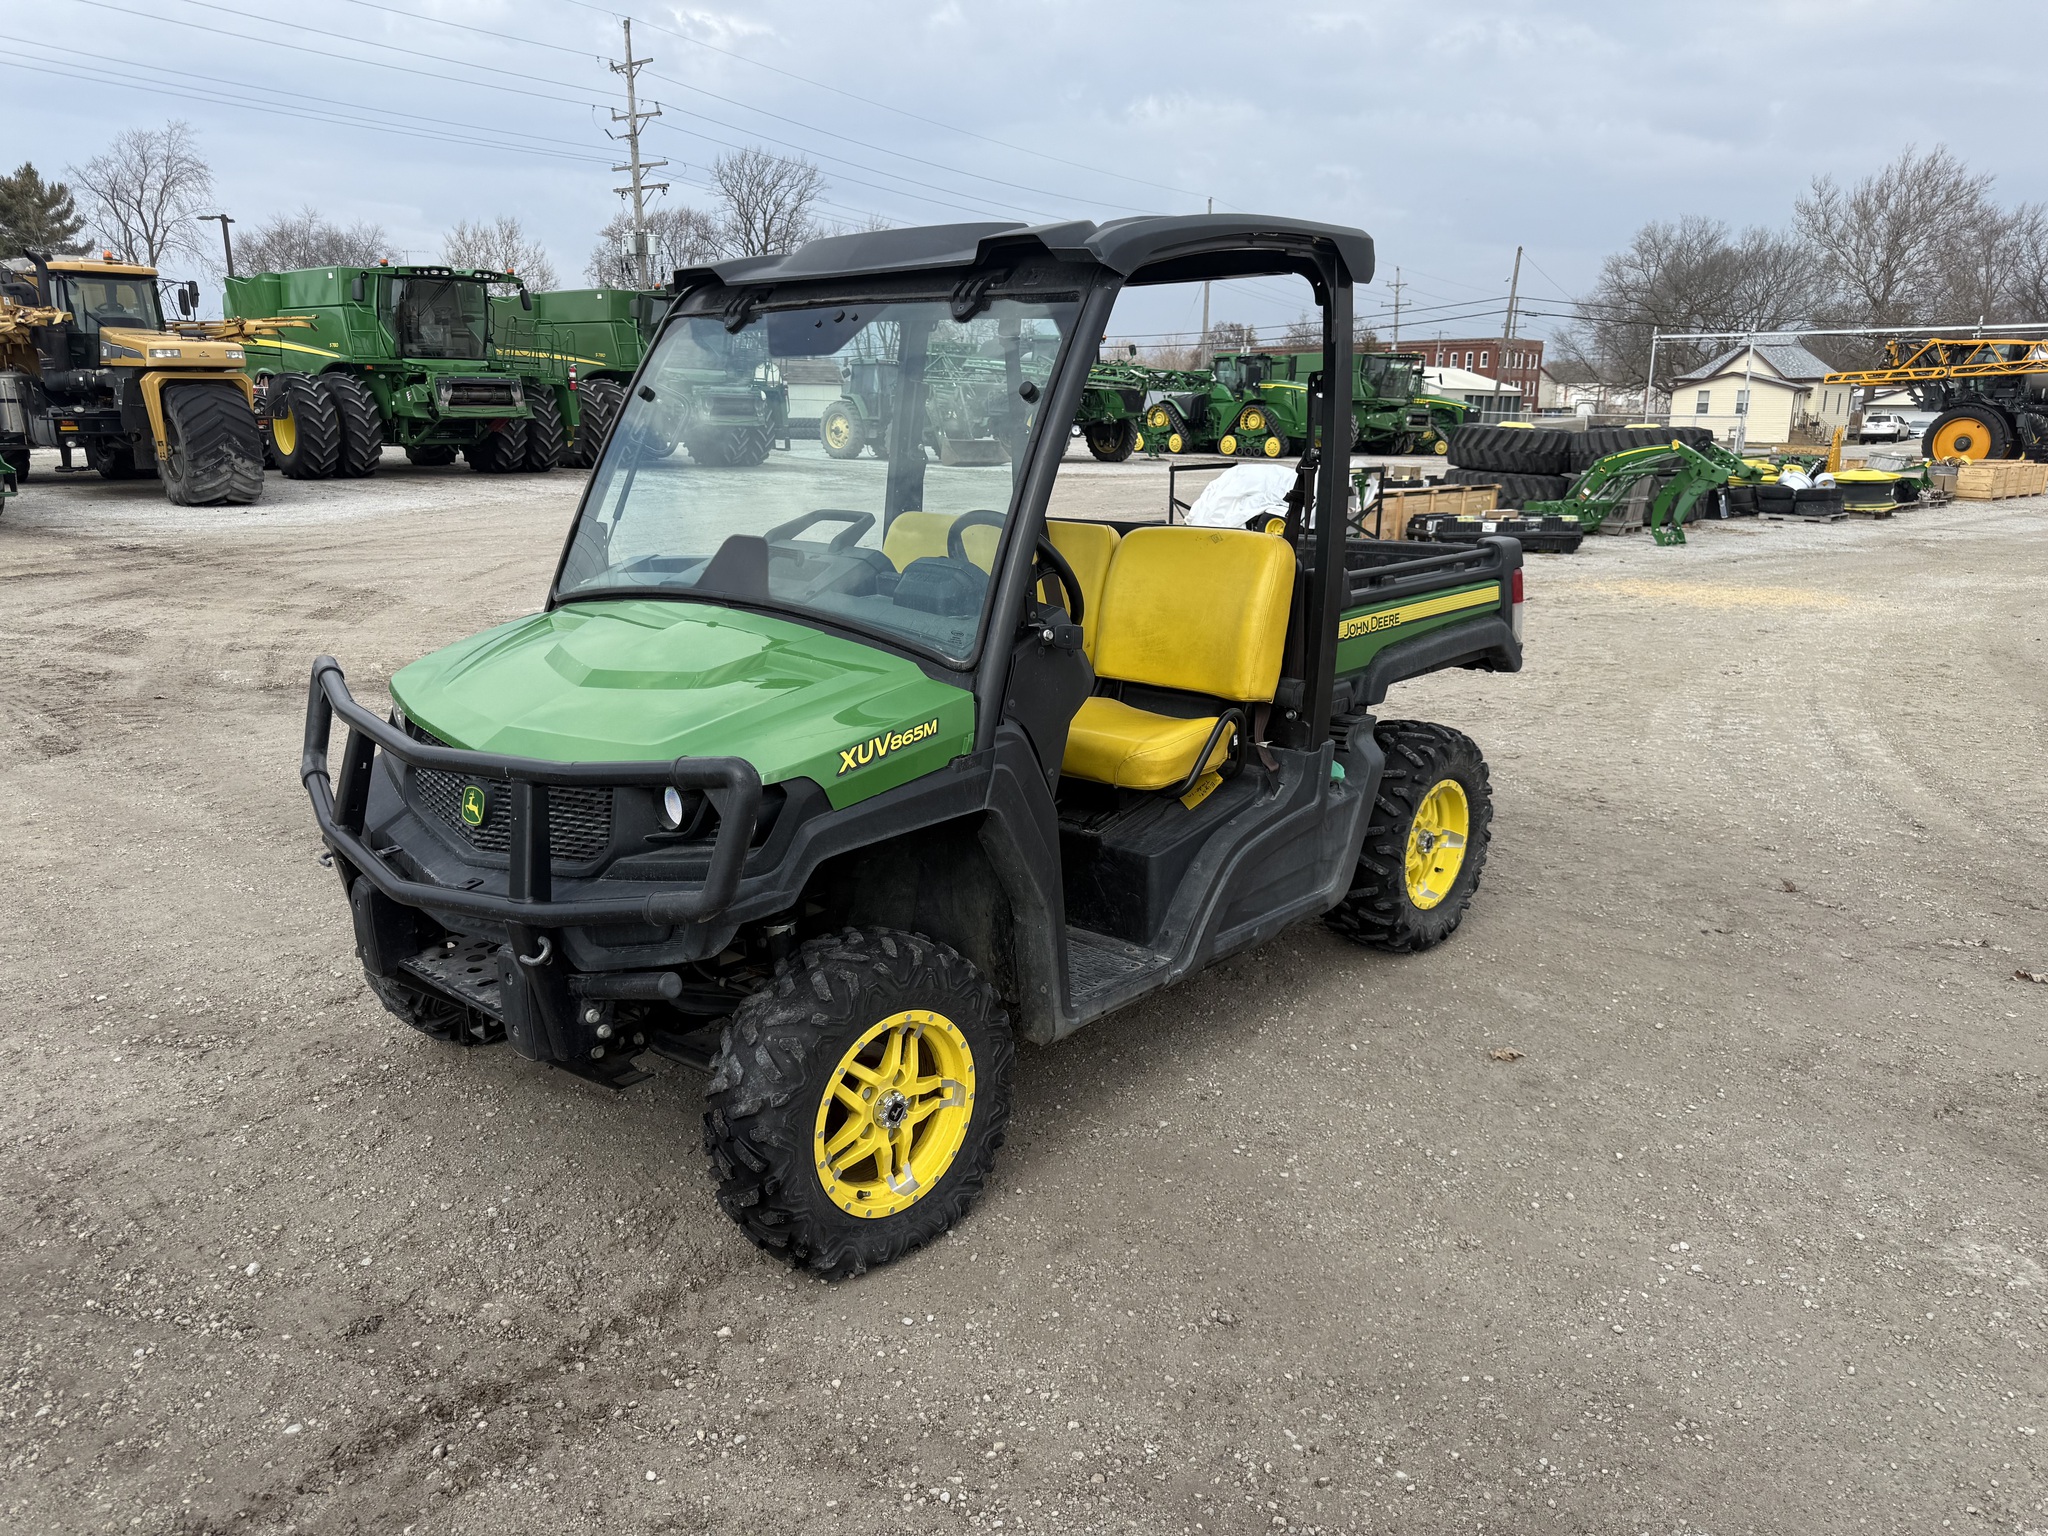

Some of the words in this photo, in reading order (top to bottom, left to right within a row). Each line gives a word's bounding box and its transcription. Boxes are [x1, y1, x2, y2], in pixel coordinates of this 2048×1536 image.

[1343, 620, 1369, 638] JOHN
[1370, 612, 1400, 631] DEERE
[837, 718, 938, 776] XUV865M
